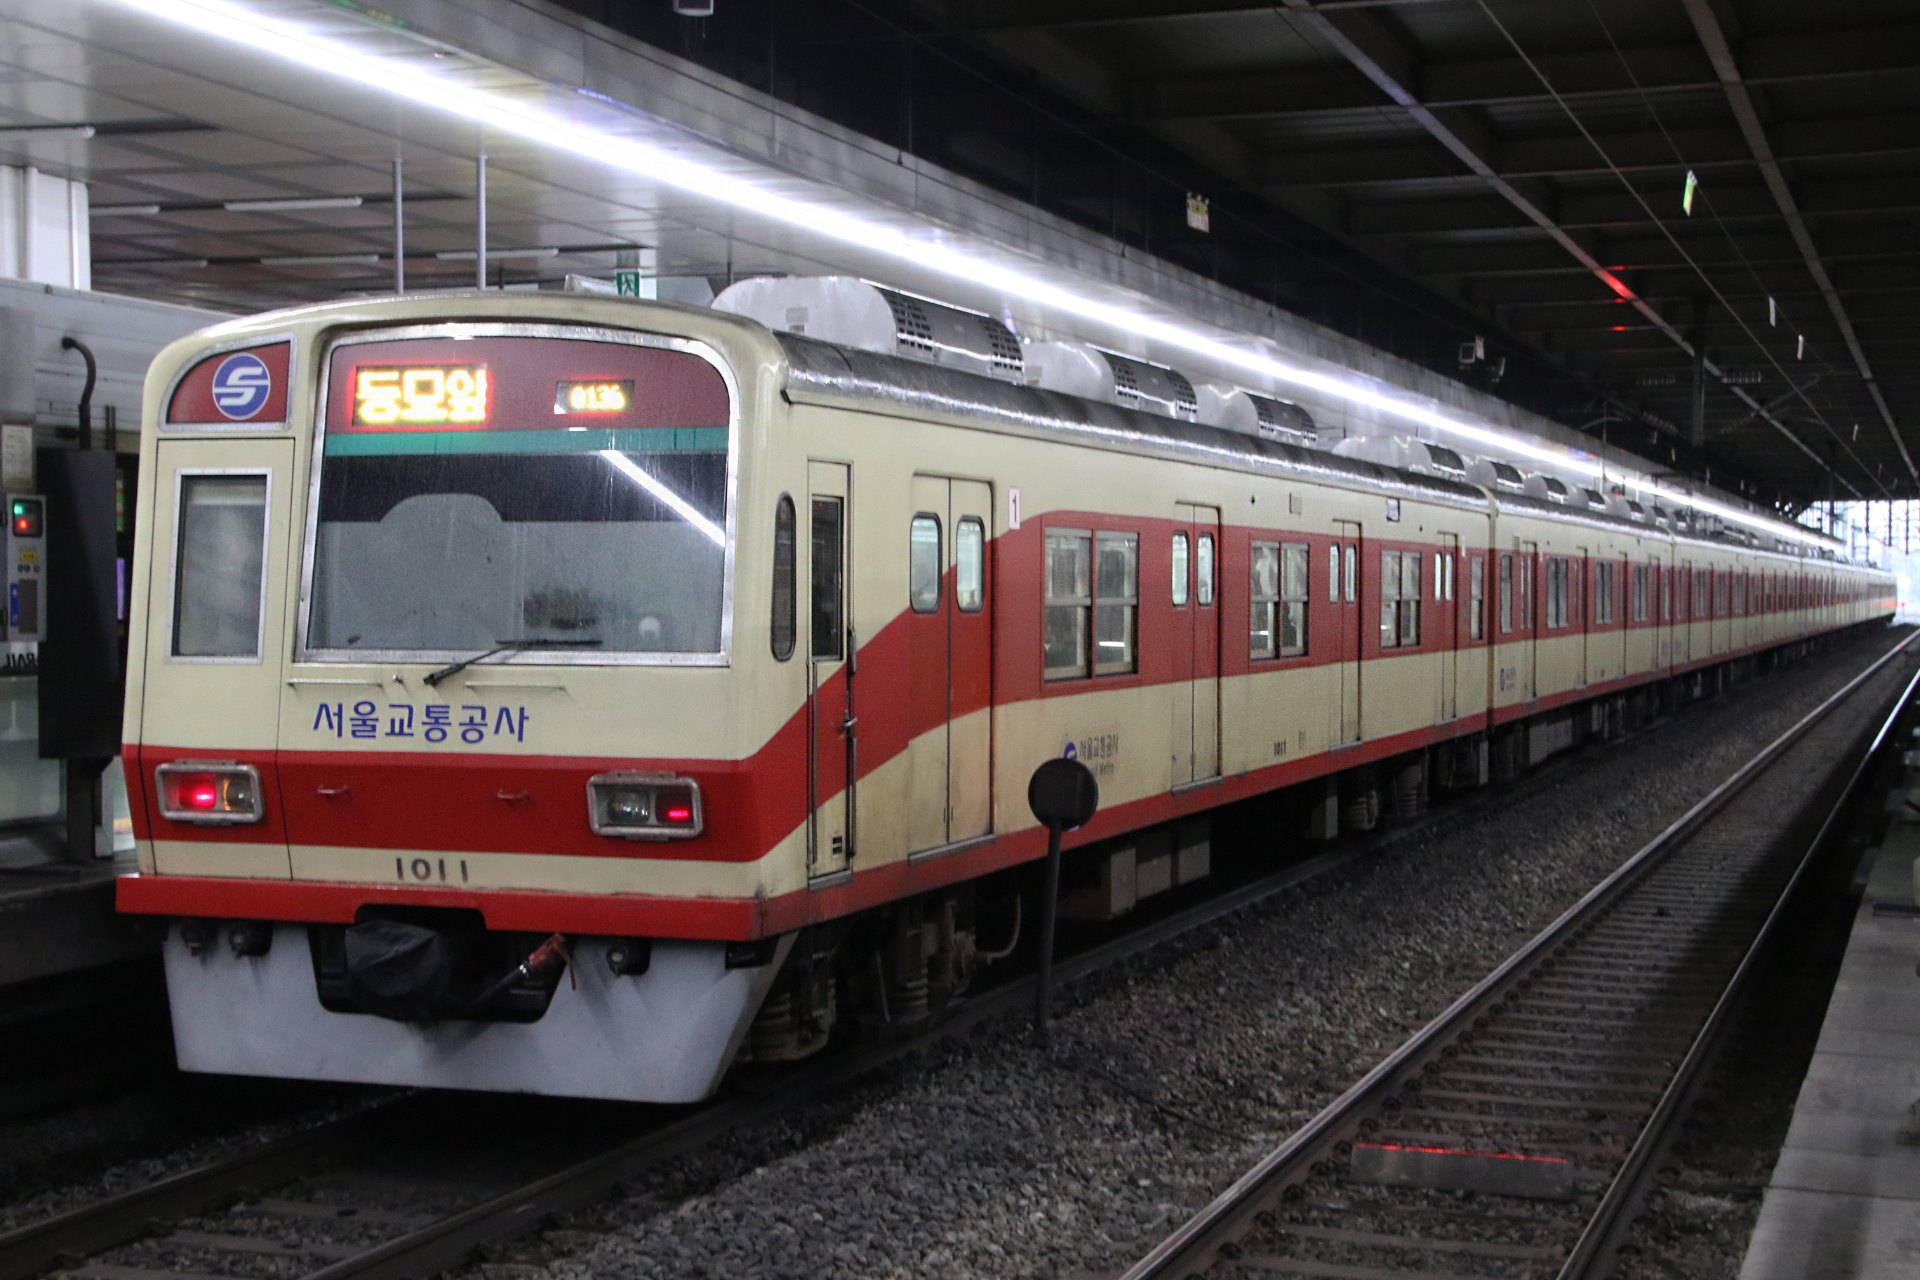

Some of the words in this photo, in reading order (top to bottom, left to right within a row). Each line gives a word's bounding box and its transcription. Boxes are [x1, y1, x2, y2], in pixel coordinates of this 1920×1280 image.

[357, 369, 488, 424] 동묘앞
[1012, 494, 1017, 522] 1
[313, 700, 529, 744] 서울교통공사
[396, 857, 469, 883] 1011
